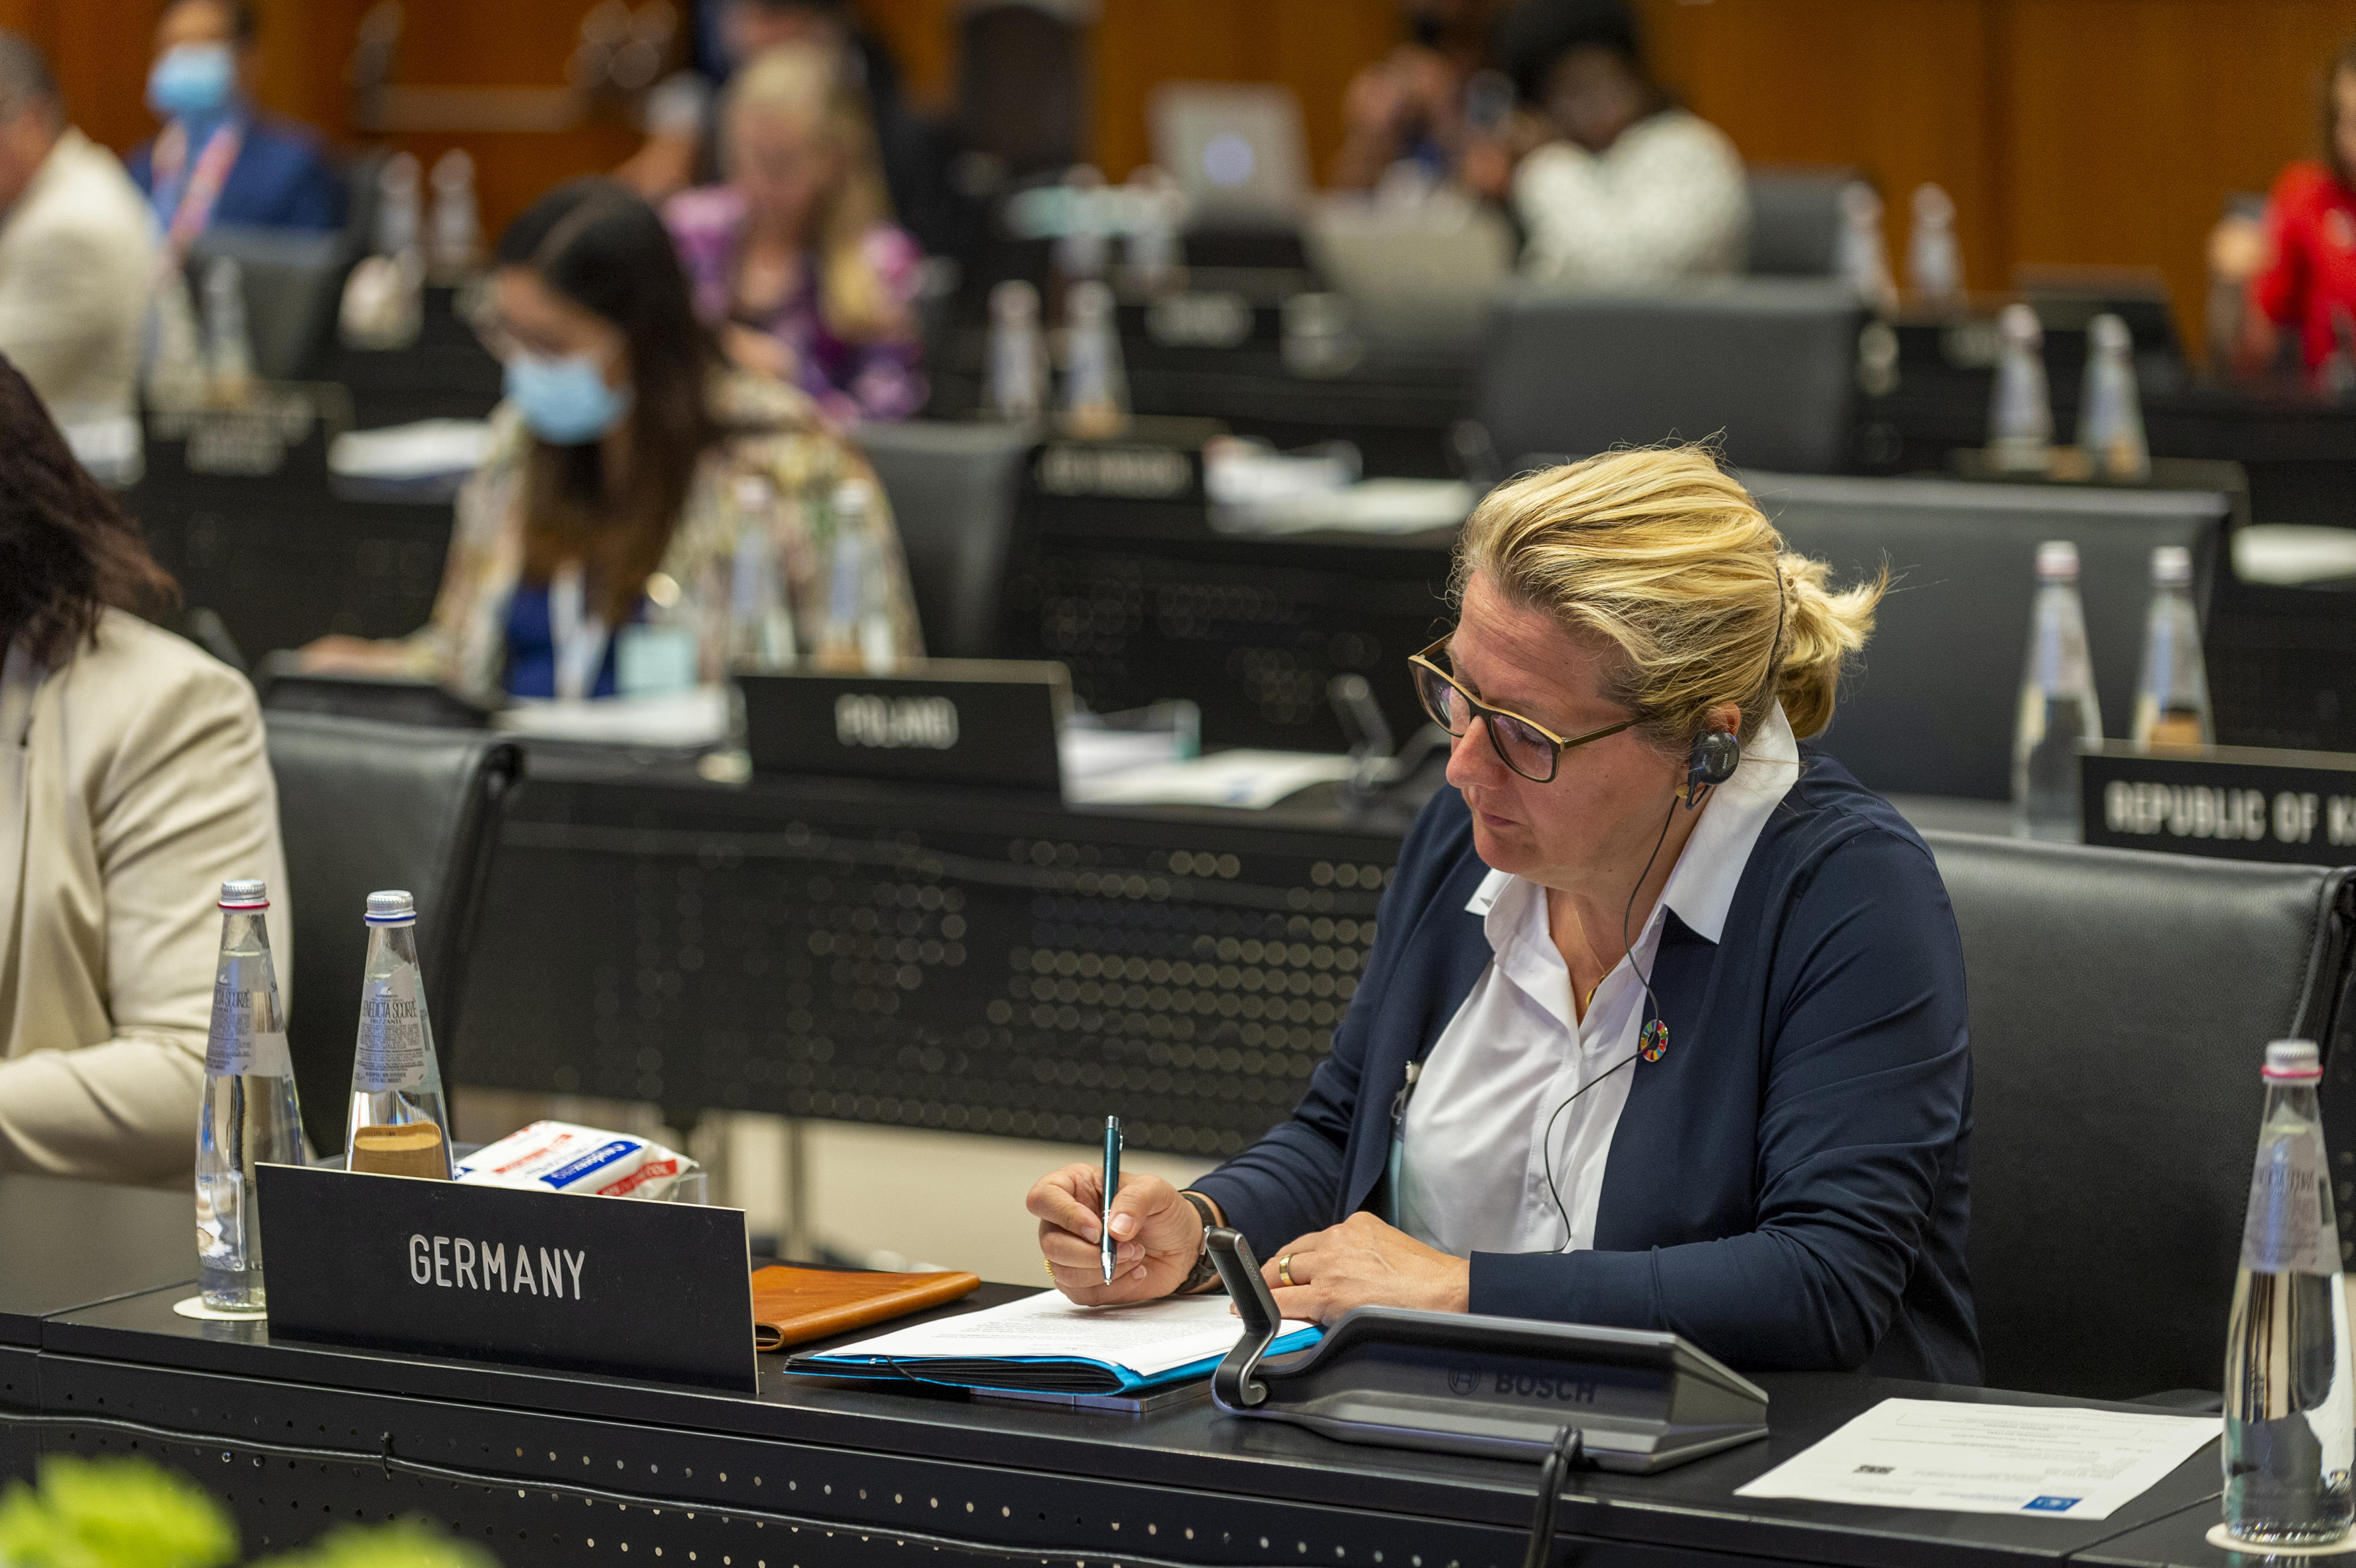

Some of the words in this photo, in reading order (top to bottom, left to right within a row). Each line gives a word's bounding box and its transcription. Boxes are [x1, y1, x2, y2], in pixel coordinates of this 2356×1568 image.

[834, 693, 959, 750] POLAND
[2104, 780, 2266, 842] REPUBLIC
[2272, 790, 2320, 844] OF
[2327, 793, 2356, 847] K
[409, 1234, 585, 1300] GERMANY
[1495, 1374, 1596, 1403] BOSCH
